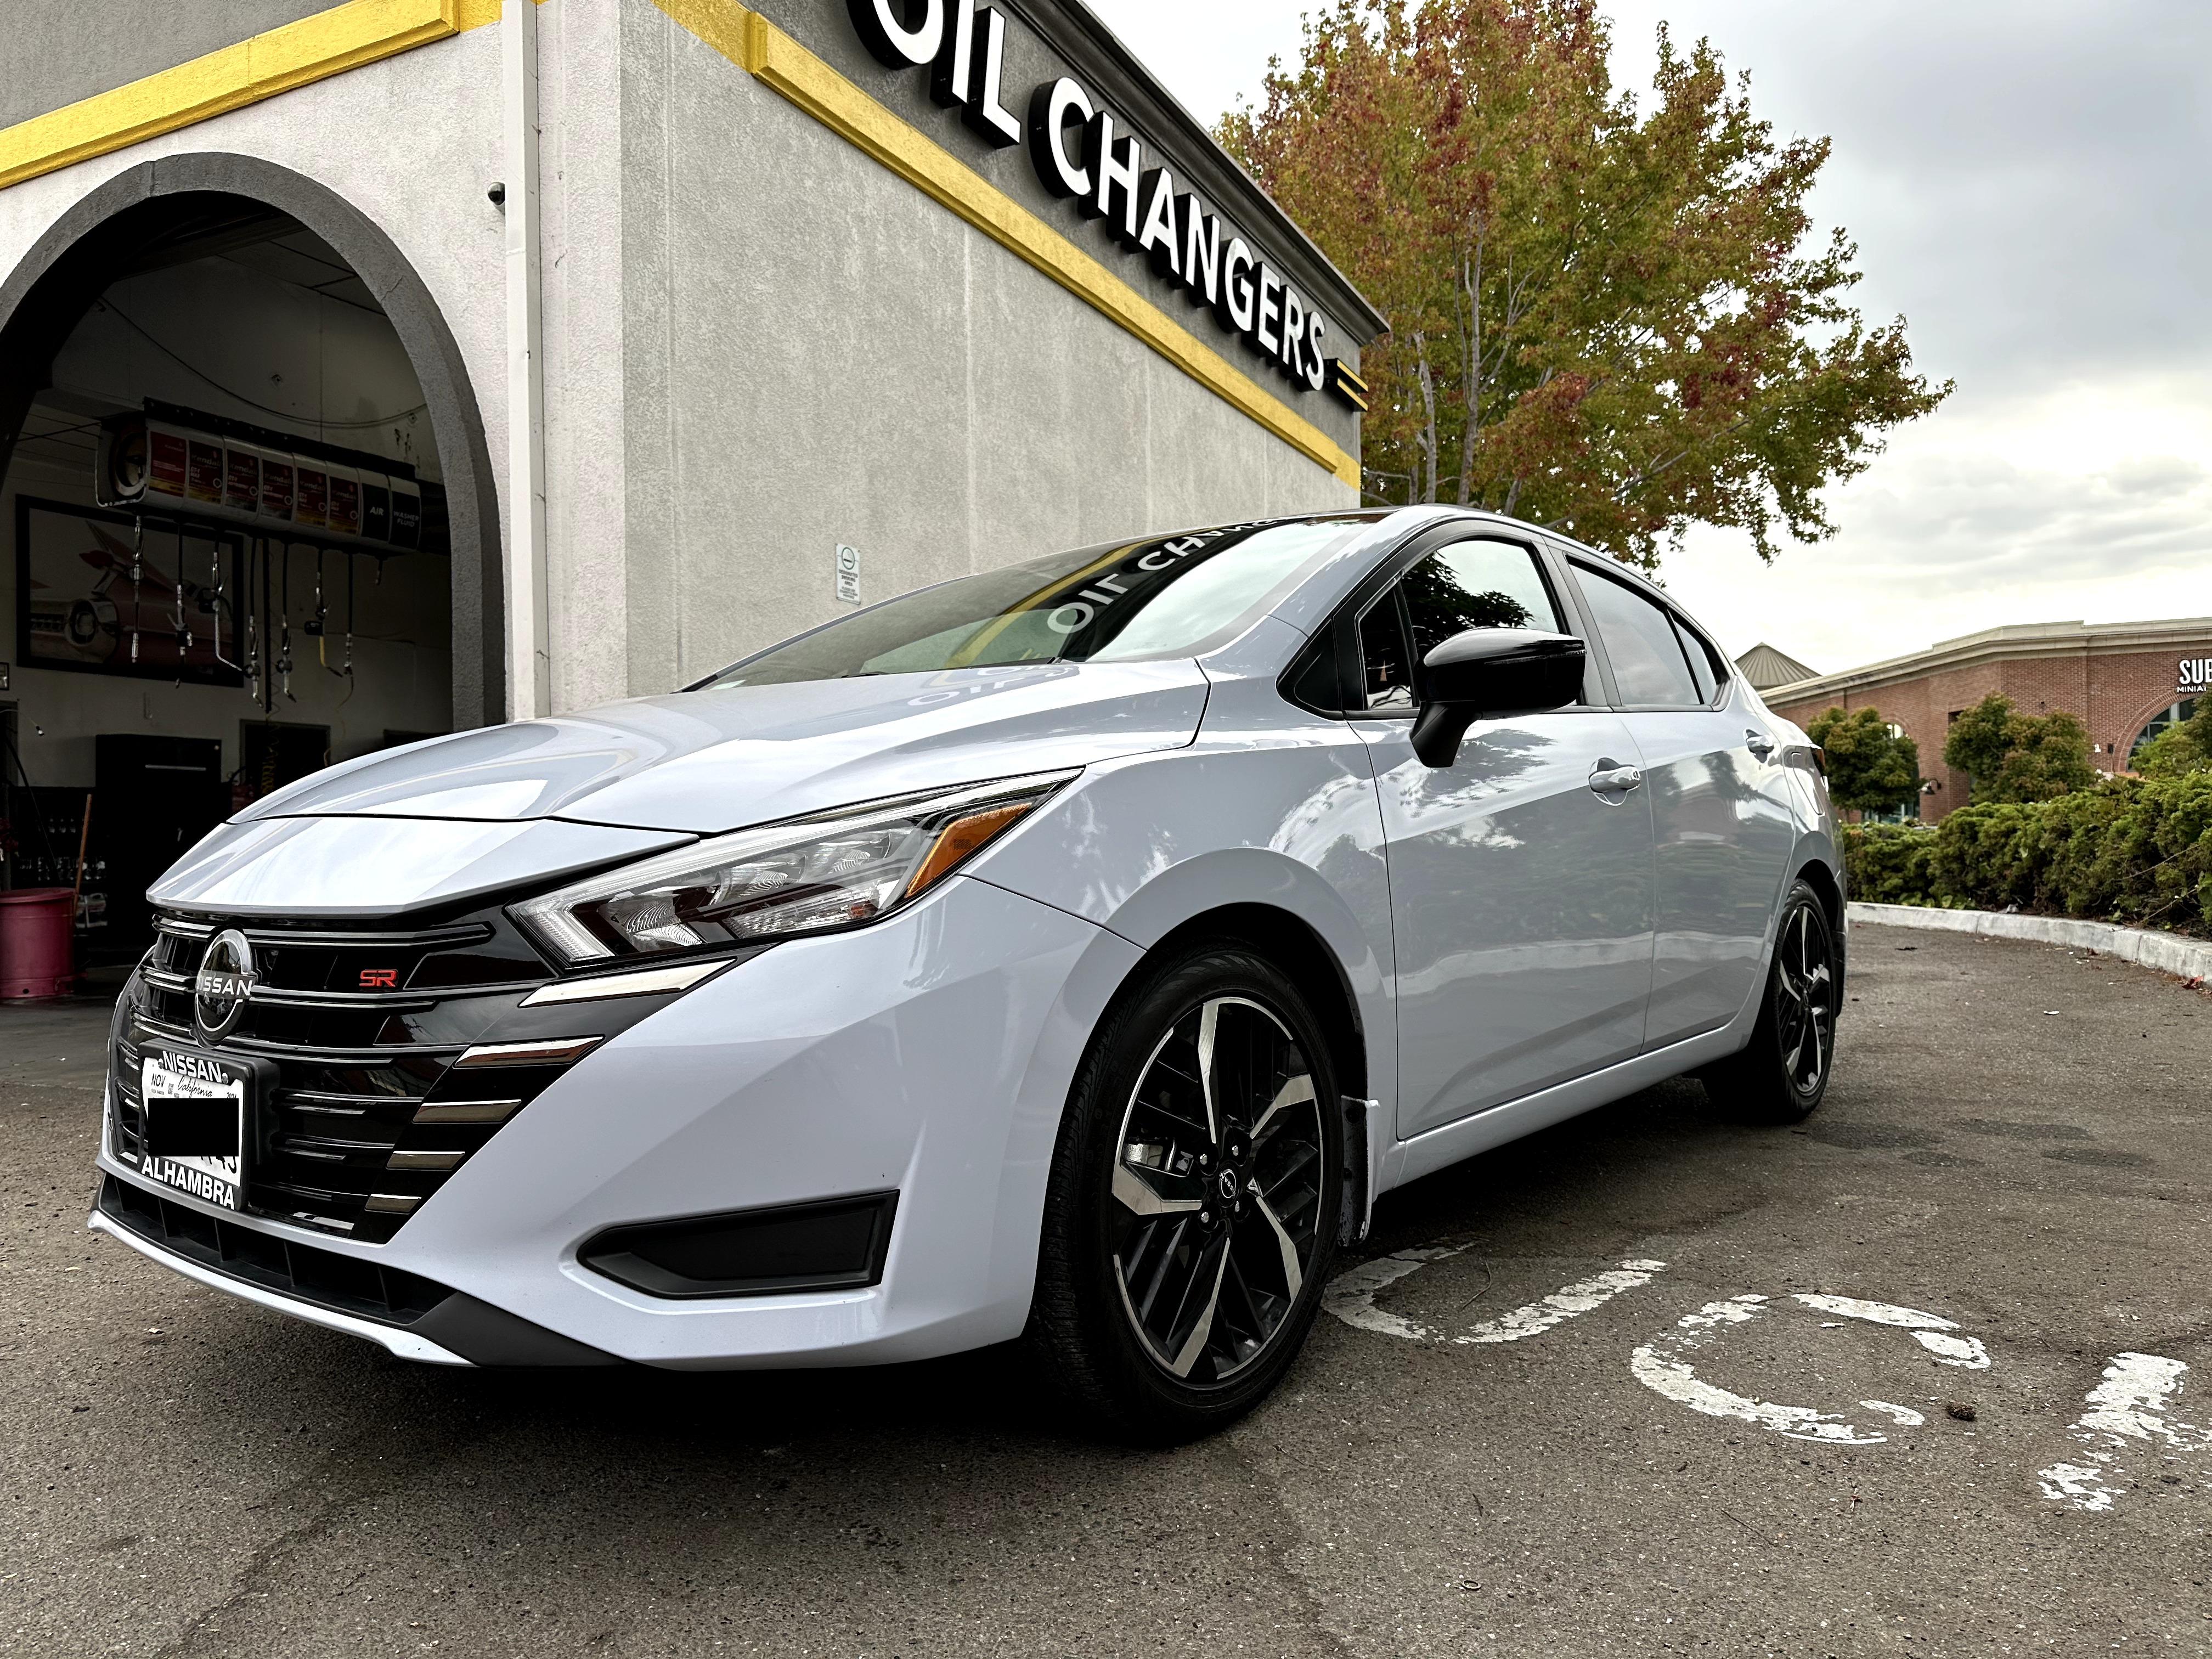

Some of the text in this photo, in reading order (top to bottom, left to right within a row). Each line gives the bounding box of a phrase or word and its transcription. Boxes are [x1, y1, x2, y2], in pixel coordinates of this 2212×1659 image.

[1048, 77, 1326, 391] CHANGERS
[369, 506, 385, 517] AIR
[393, 510, 420, 522] WASHER
[396, 518, 415, 528] FLUID
[359, 969, 398, 988] SR
[163, 1050, 222, 1084] NISSAN
[151, 1073, 166, 1088] NOV
[177, 1075, 213, 1098] California
[141, 1154, 235, 1210] ALHAMBRA
